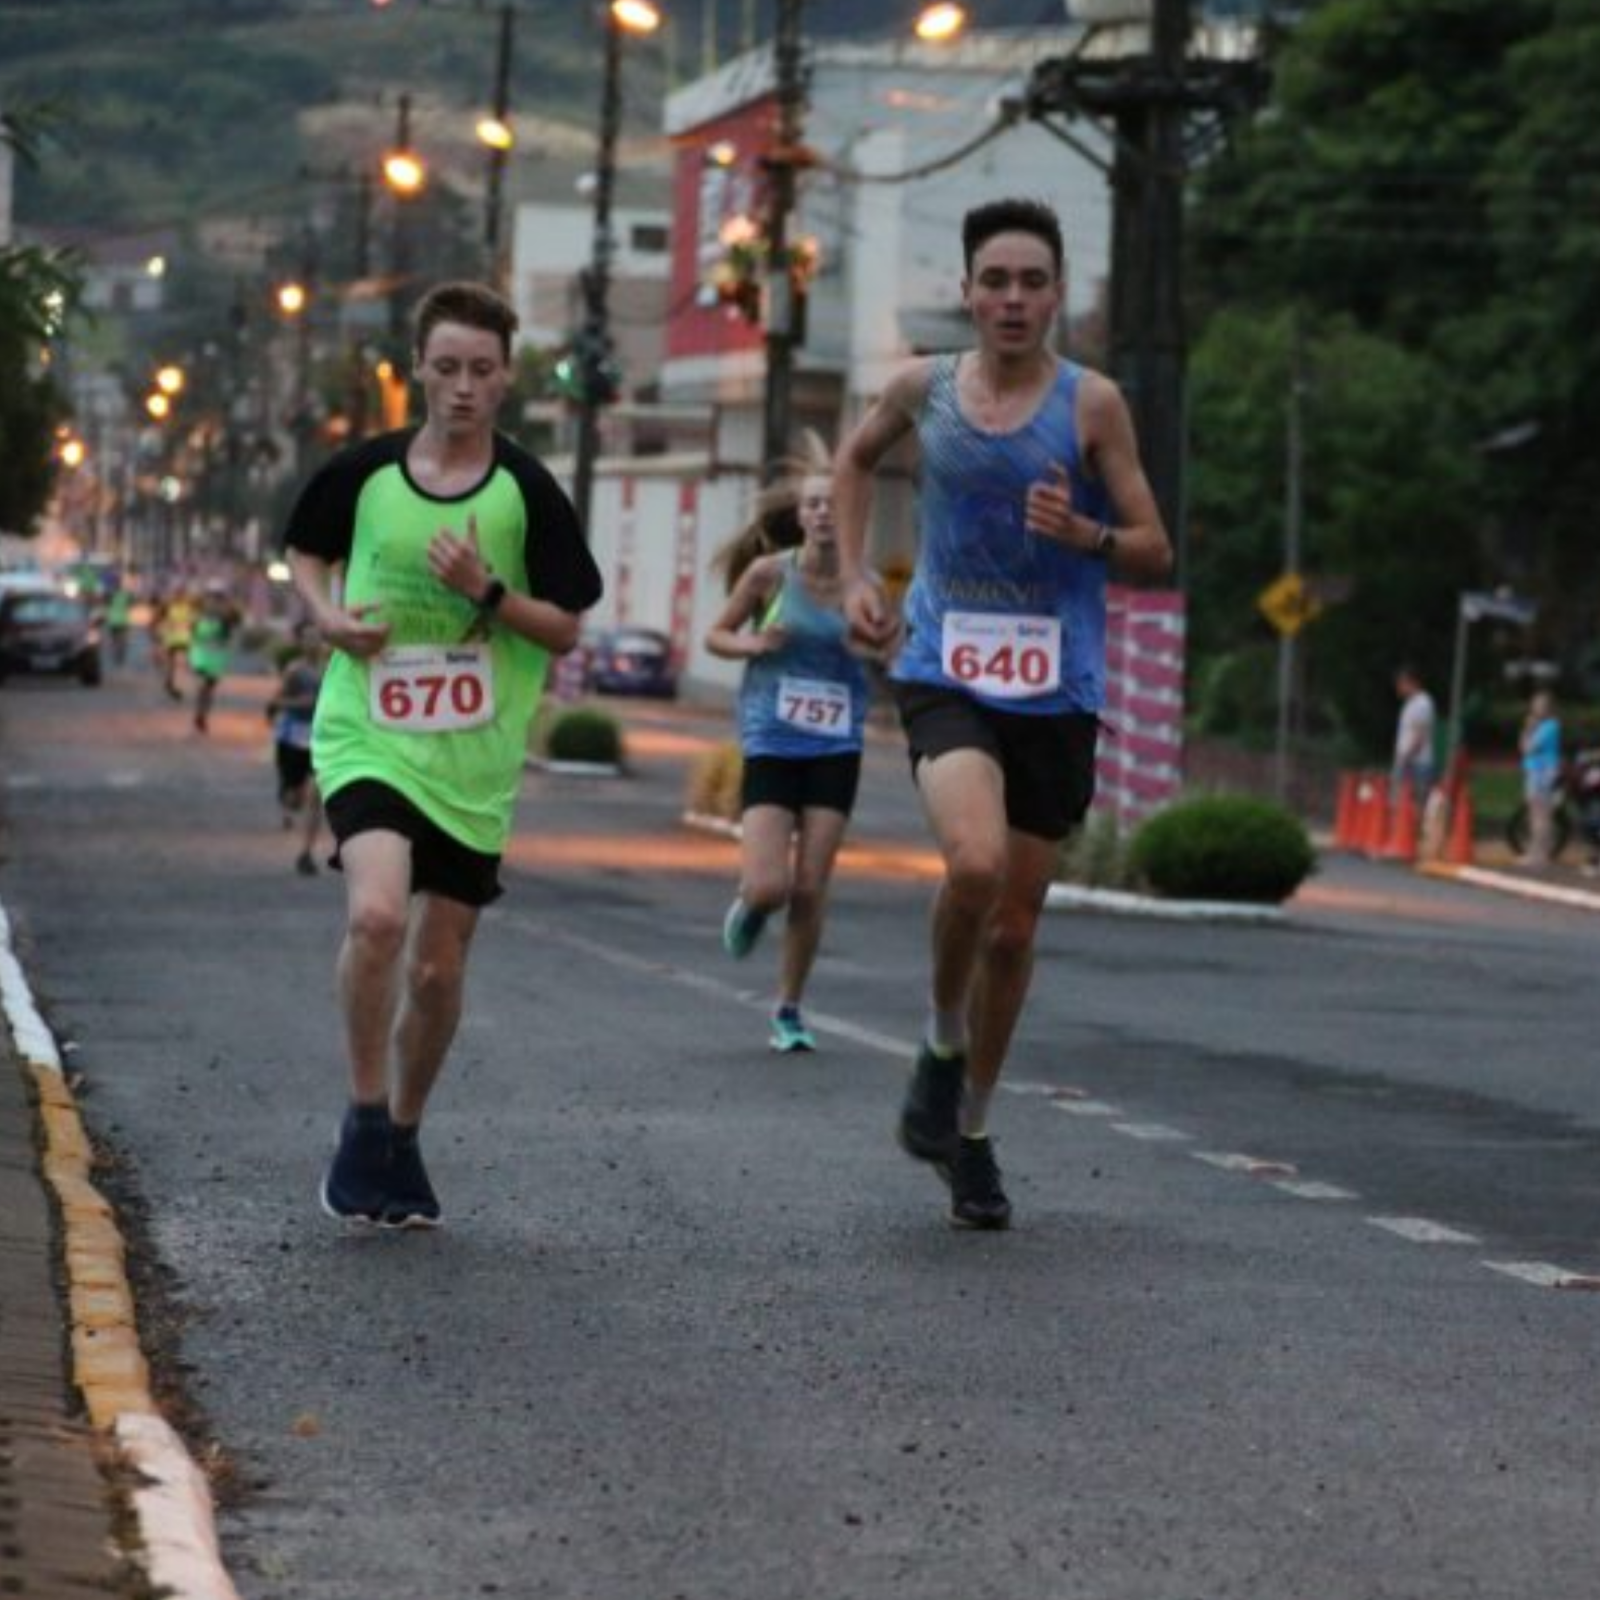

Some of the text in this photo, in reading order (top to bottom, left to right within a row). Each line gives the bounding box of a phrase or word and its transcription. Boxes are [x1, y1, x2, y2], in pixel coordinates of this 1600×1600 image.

[950, 643, 1050, 686] 640
[379, 672, 484, 720] 670
[784, 694, 845, 726] 757
